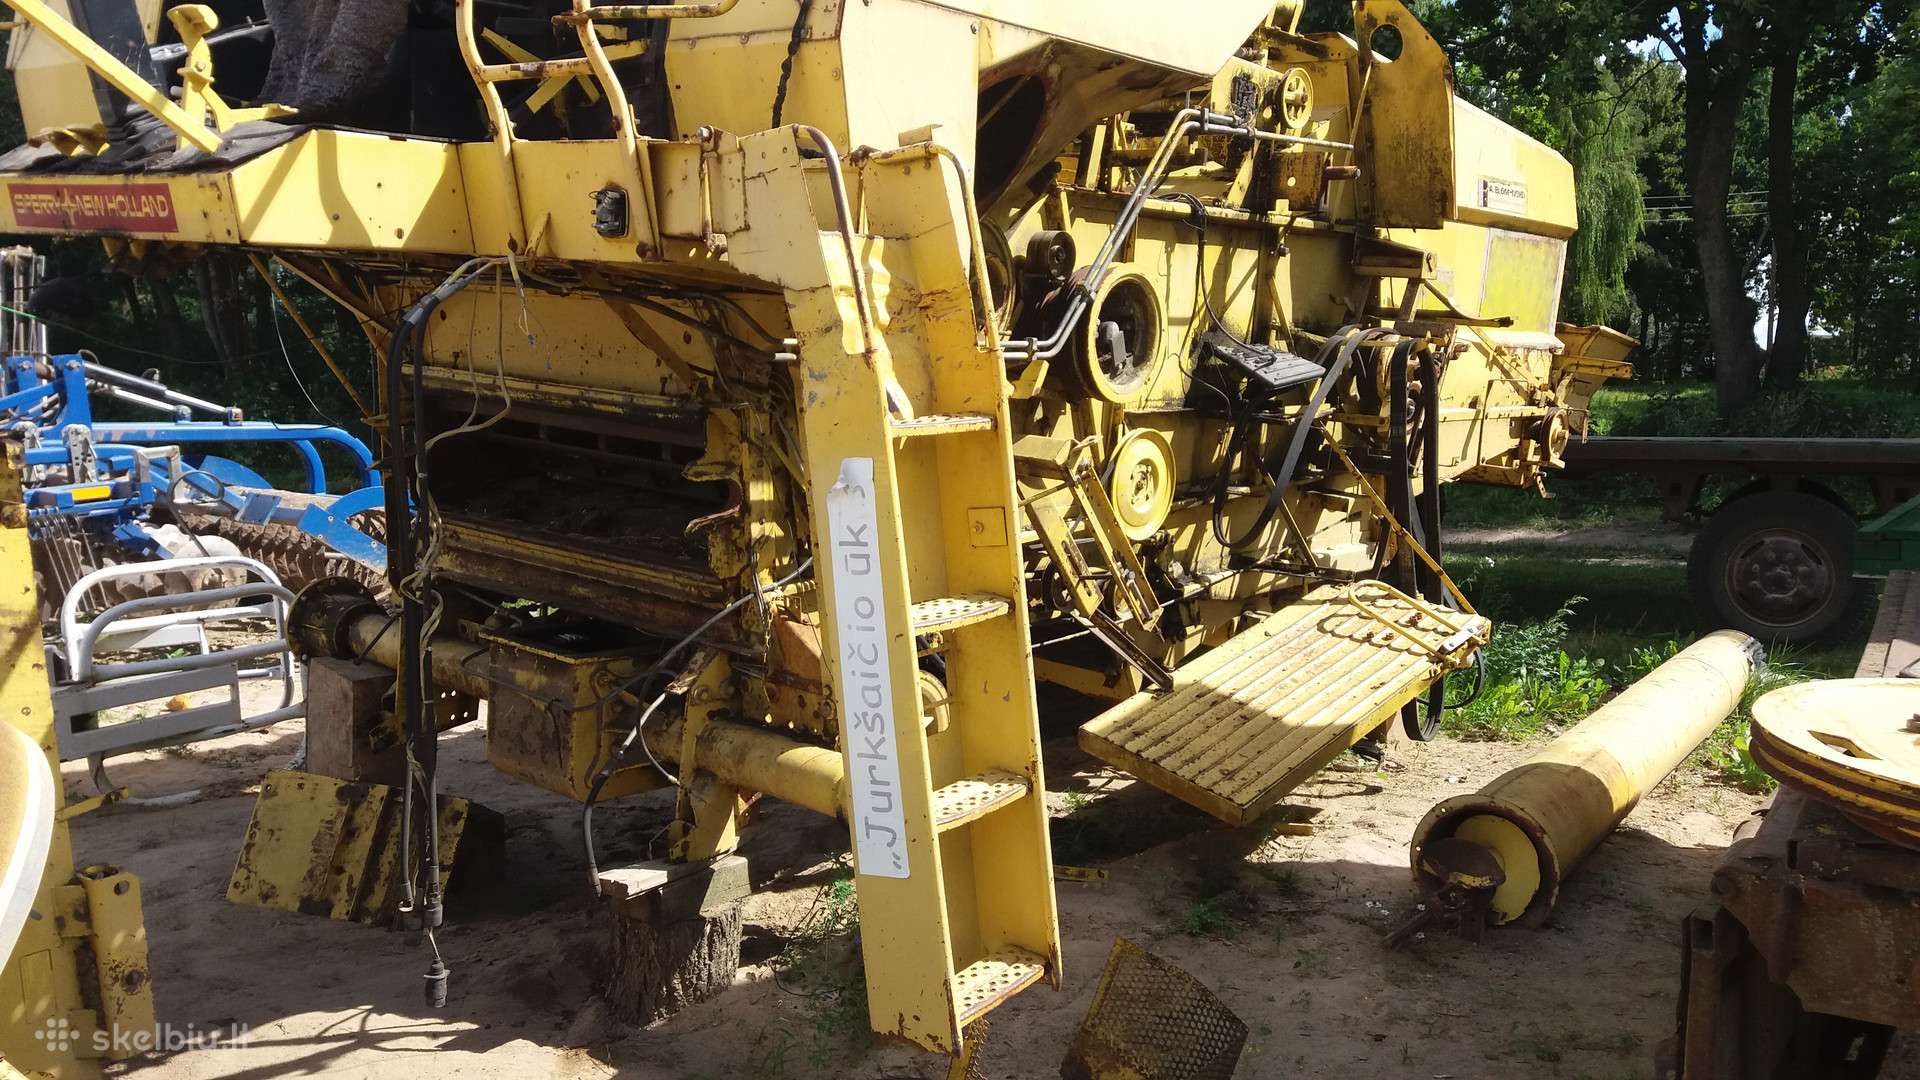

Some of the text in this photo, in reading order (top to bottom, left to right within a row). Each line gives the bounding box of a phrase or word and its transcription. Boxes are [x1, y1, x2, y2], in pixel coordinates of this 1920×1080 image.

[14, 193, 169, 217] SPERRY NEW HOLLAND
